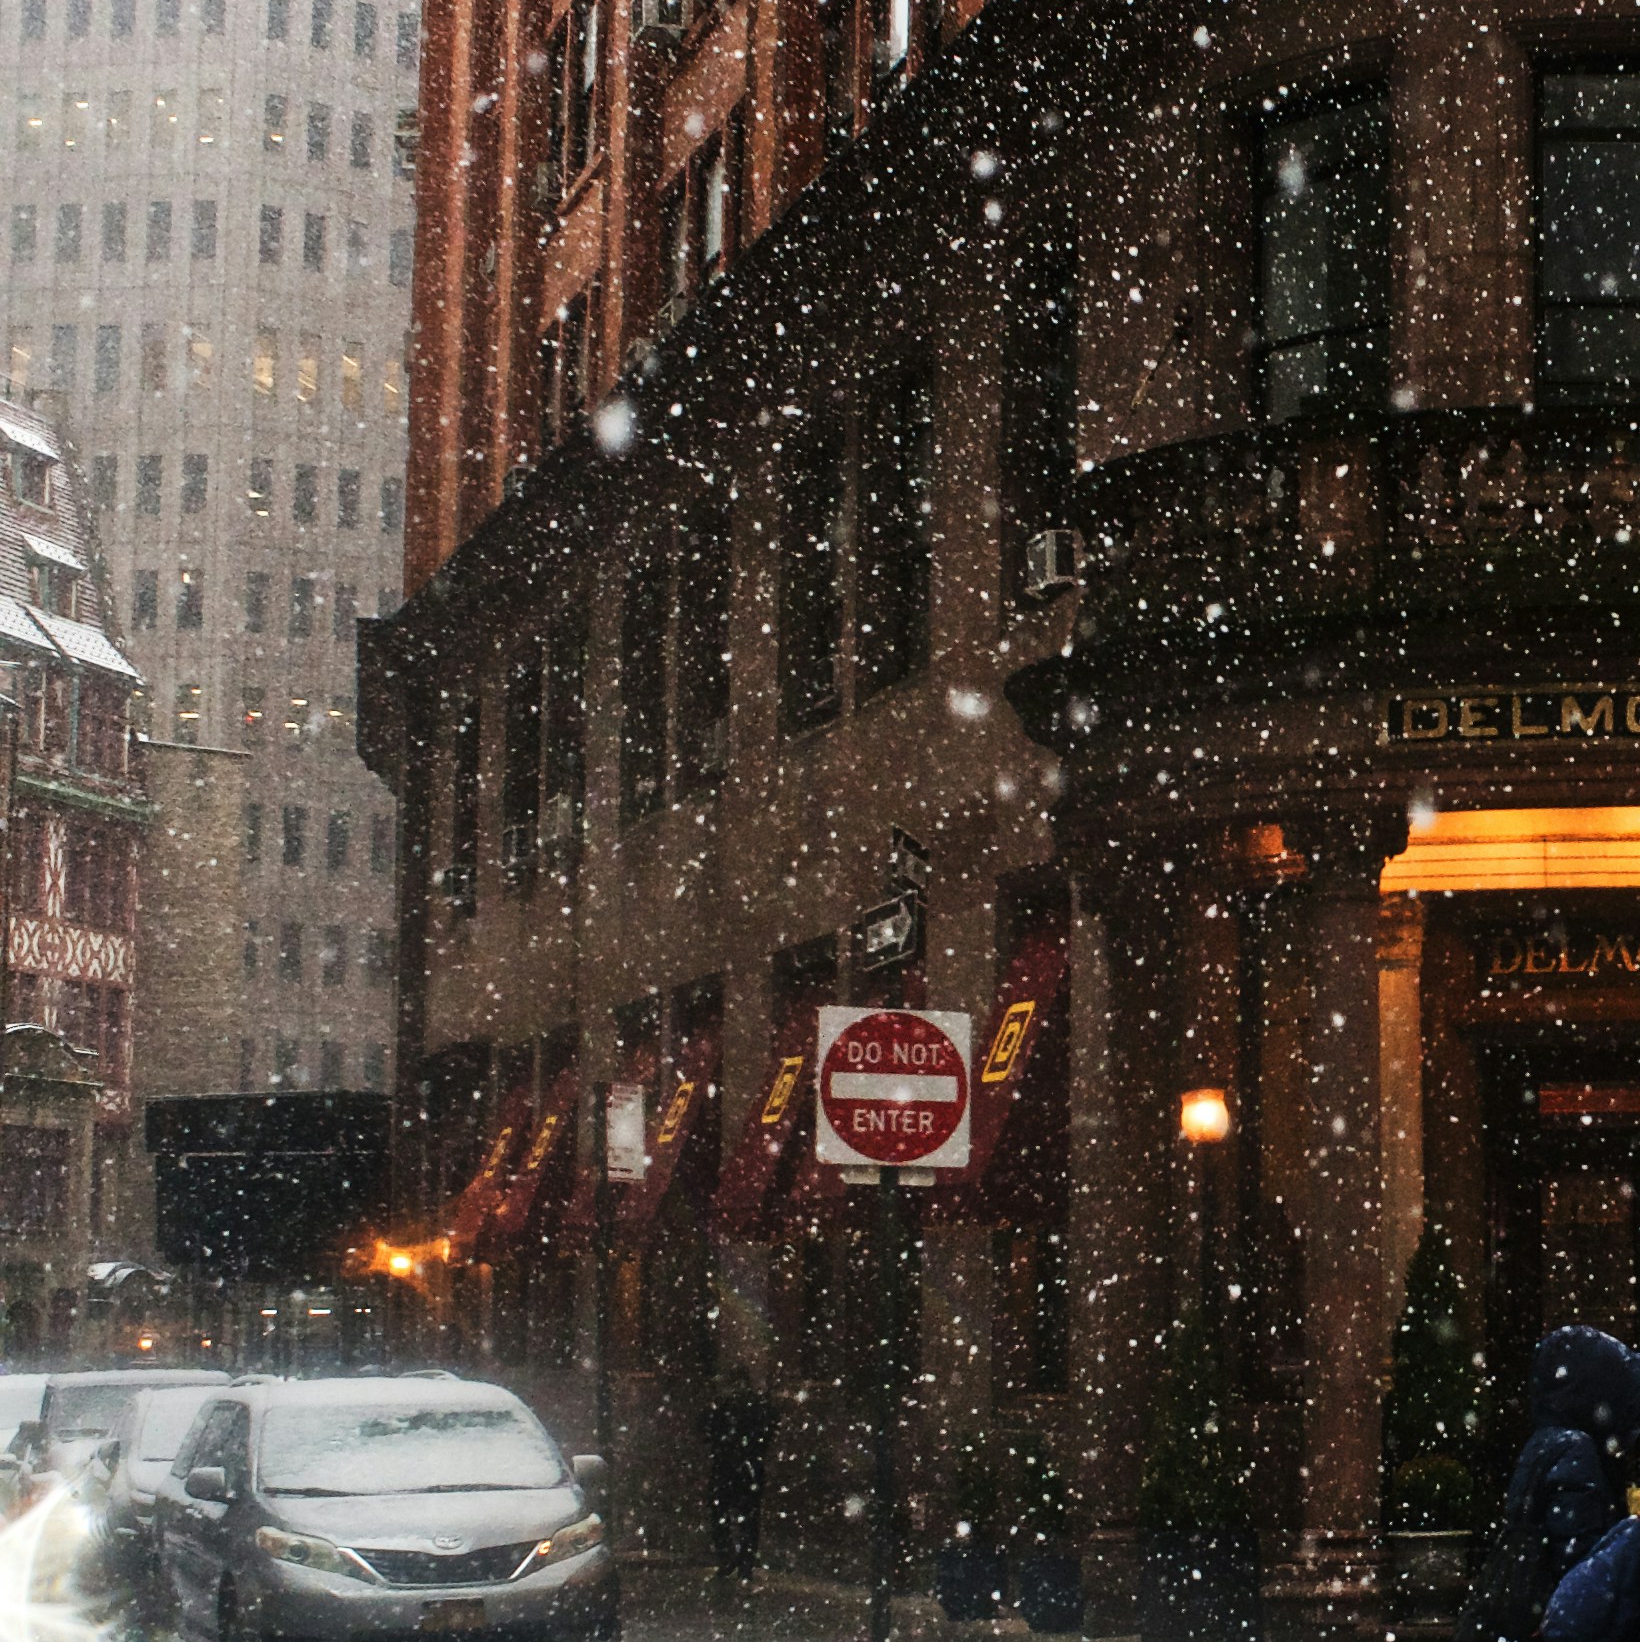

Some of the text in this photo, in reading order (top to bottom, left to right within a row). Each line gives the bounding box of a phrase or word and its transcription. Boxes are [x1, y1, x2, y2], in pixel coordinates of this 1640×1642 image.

[847, 1041, 941, 1066] DO NOT
[852, 1109, 935, 1134] ENTER
